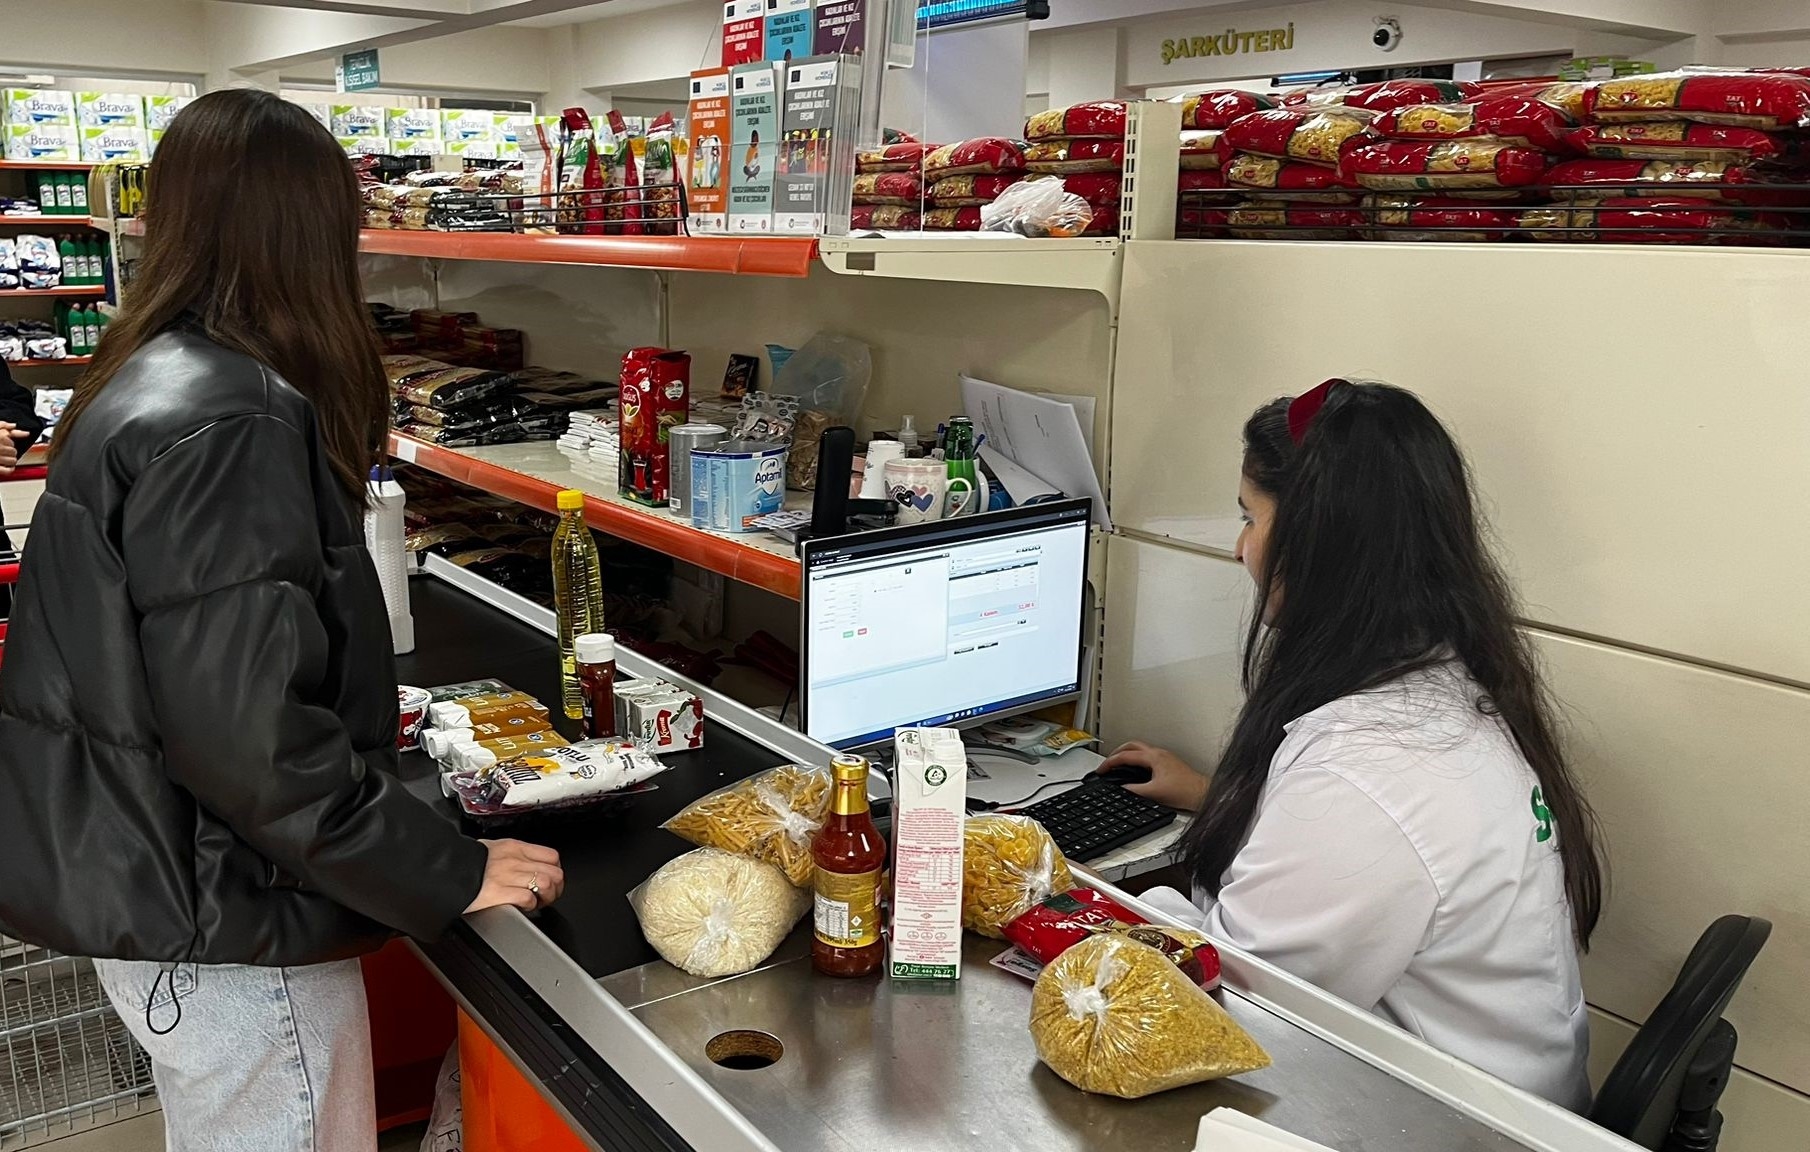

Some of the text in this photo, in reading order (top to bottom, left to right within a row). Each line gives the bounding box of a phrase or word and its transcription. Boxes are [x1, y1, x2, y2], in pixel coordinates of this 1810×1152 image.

[1161, 22, 1294, 65] ŞARKÜTERİ
[32, 100, 64, 112] Brava
[99, 102, 131, 113] Brava
[349, 113, 375, 125] Brava
[404, 116, 431, 128] Brava
[460, 118, 485, 129] Brava
[30, 135, 62, 147] Brava
[103, 136, 135, 148] Brava
[467, 149, 493, 158] Brava
[755, 467, 782, 485] Aptamil
[1032, 945, 1042, 955] TAT
